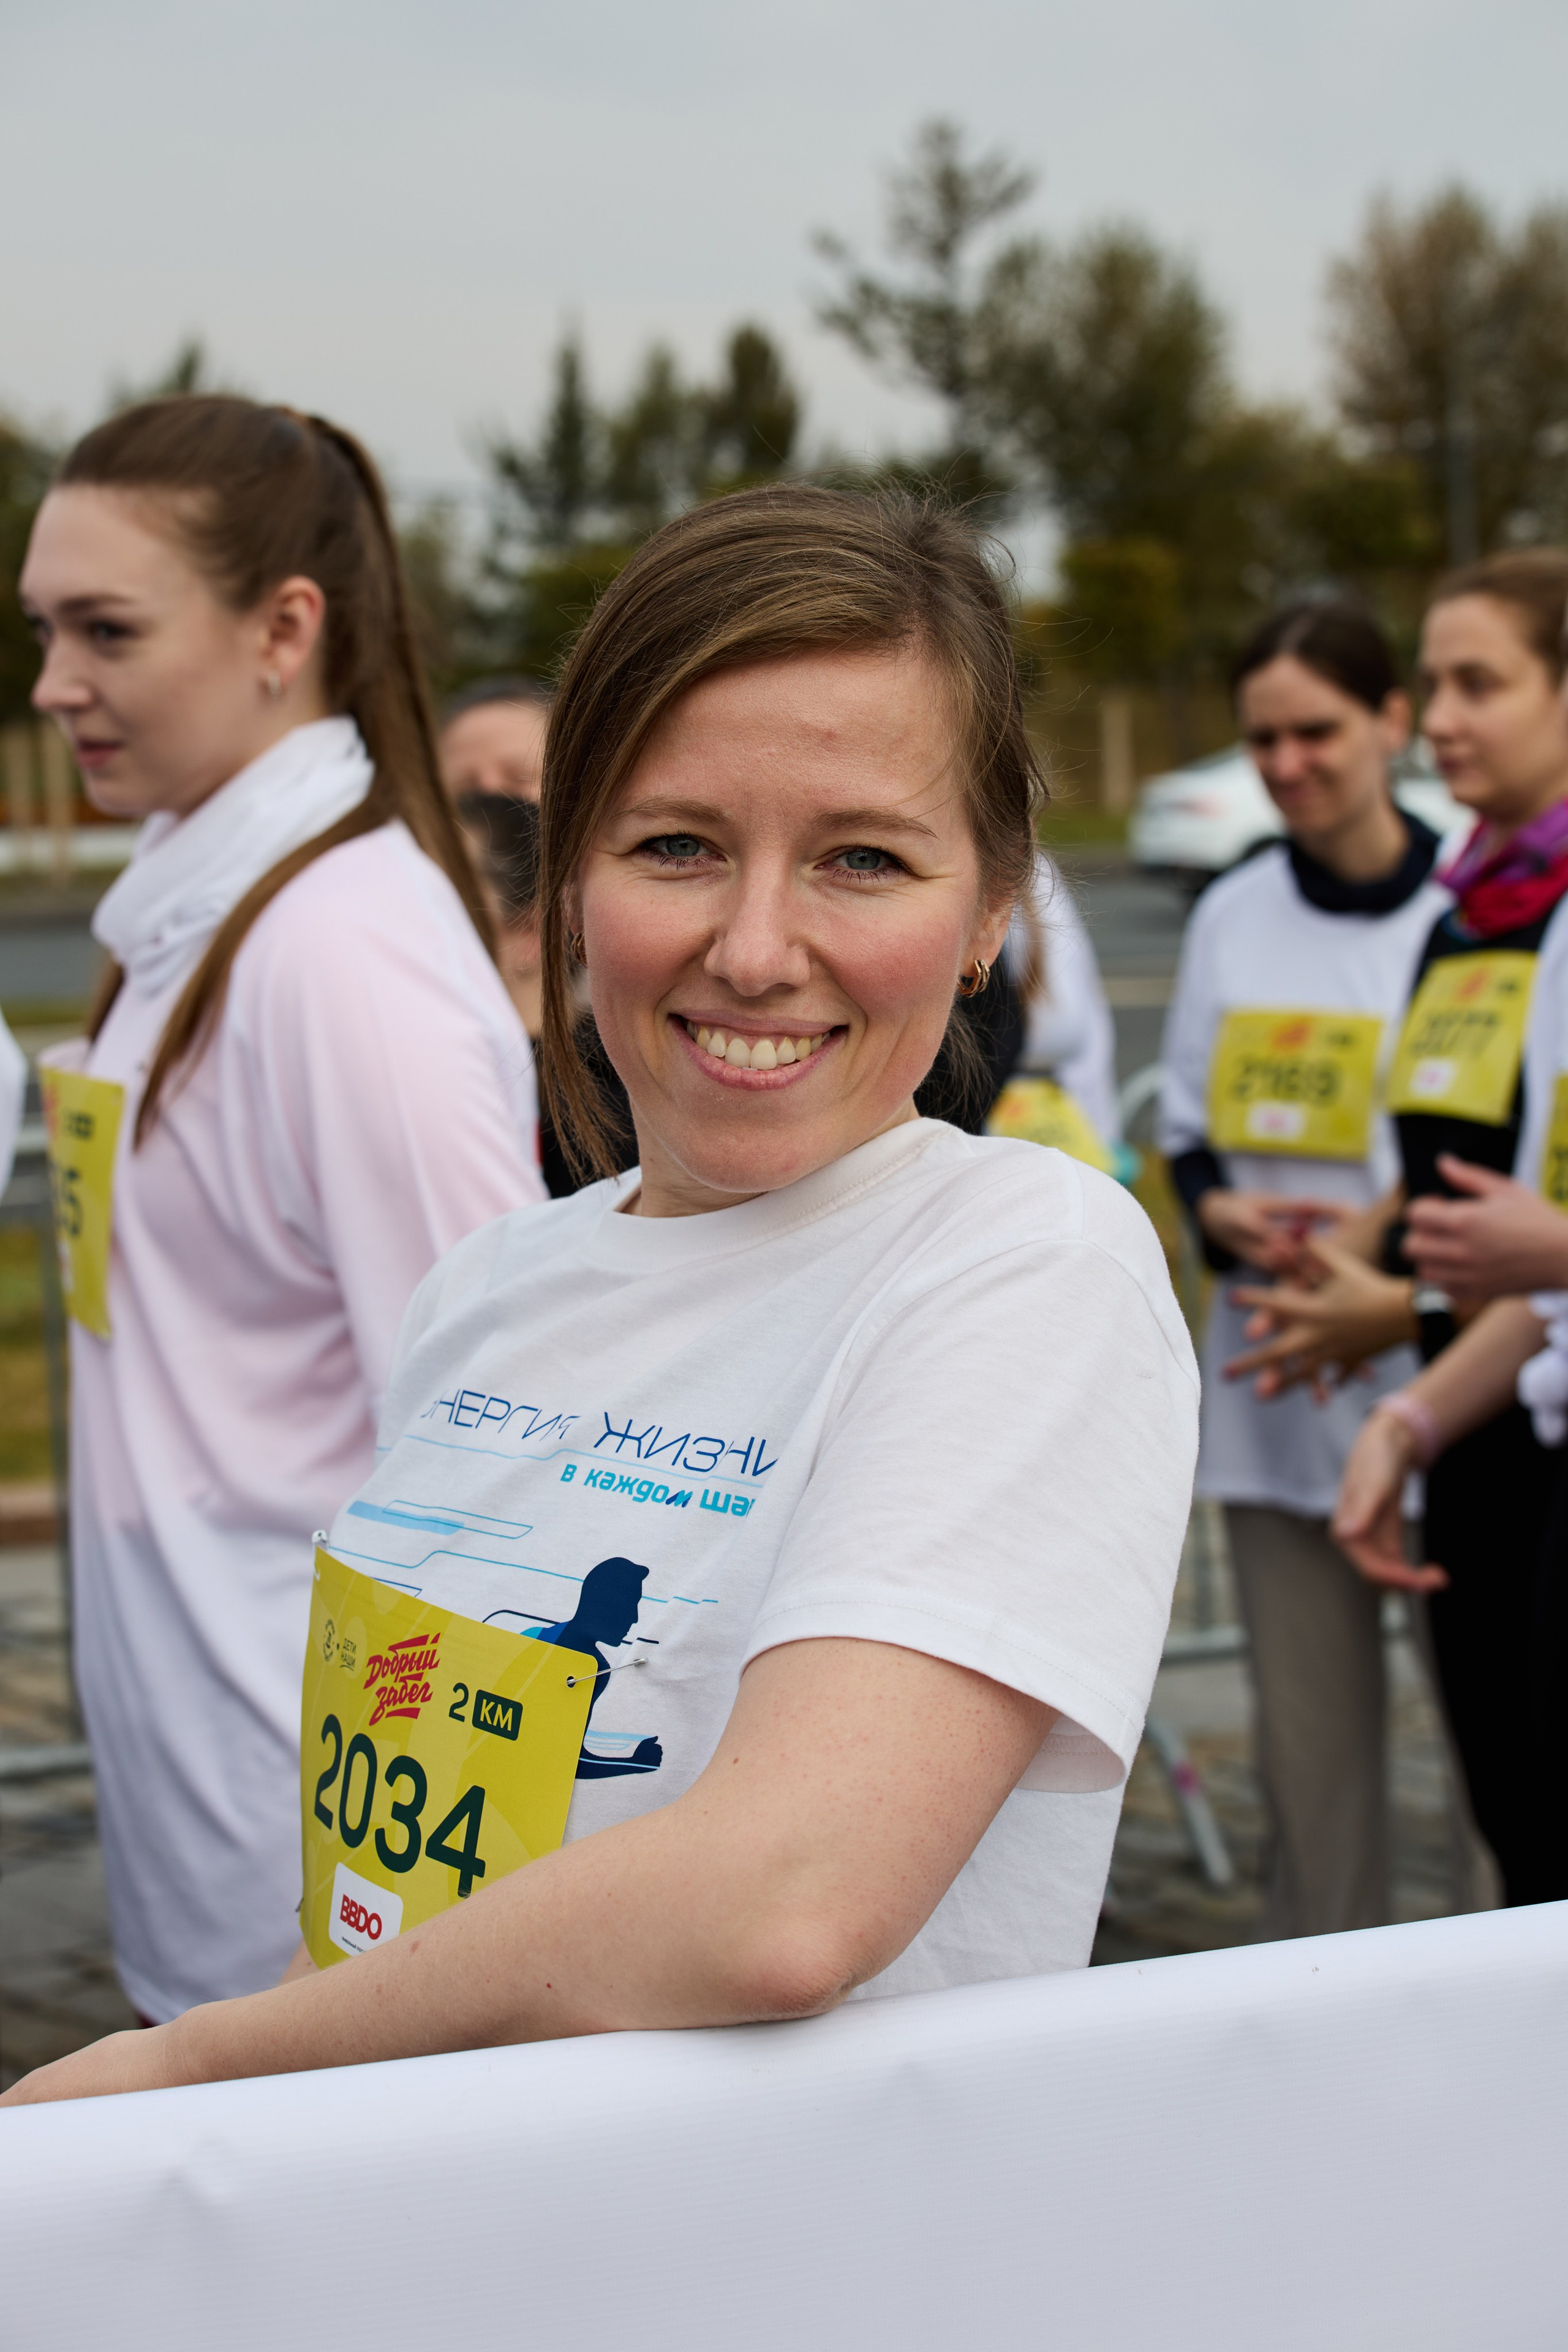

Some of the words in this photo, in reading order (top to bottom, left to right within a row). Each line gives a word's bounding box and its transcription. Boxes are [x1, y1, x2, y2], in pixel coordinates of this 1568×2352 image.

[420, 1389, 582, 1442] НЕРГИЯ
[583, 1468, 693, 1508] каждом
[363, 1632, 441, 1690] Добрый
[369, 1672, 434, 1726] забег
[448, 1683, 469, 1722] 2
[314, 1713, 486, 1898] 2034
[340, 1893, 382, 1940] BBDO
